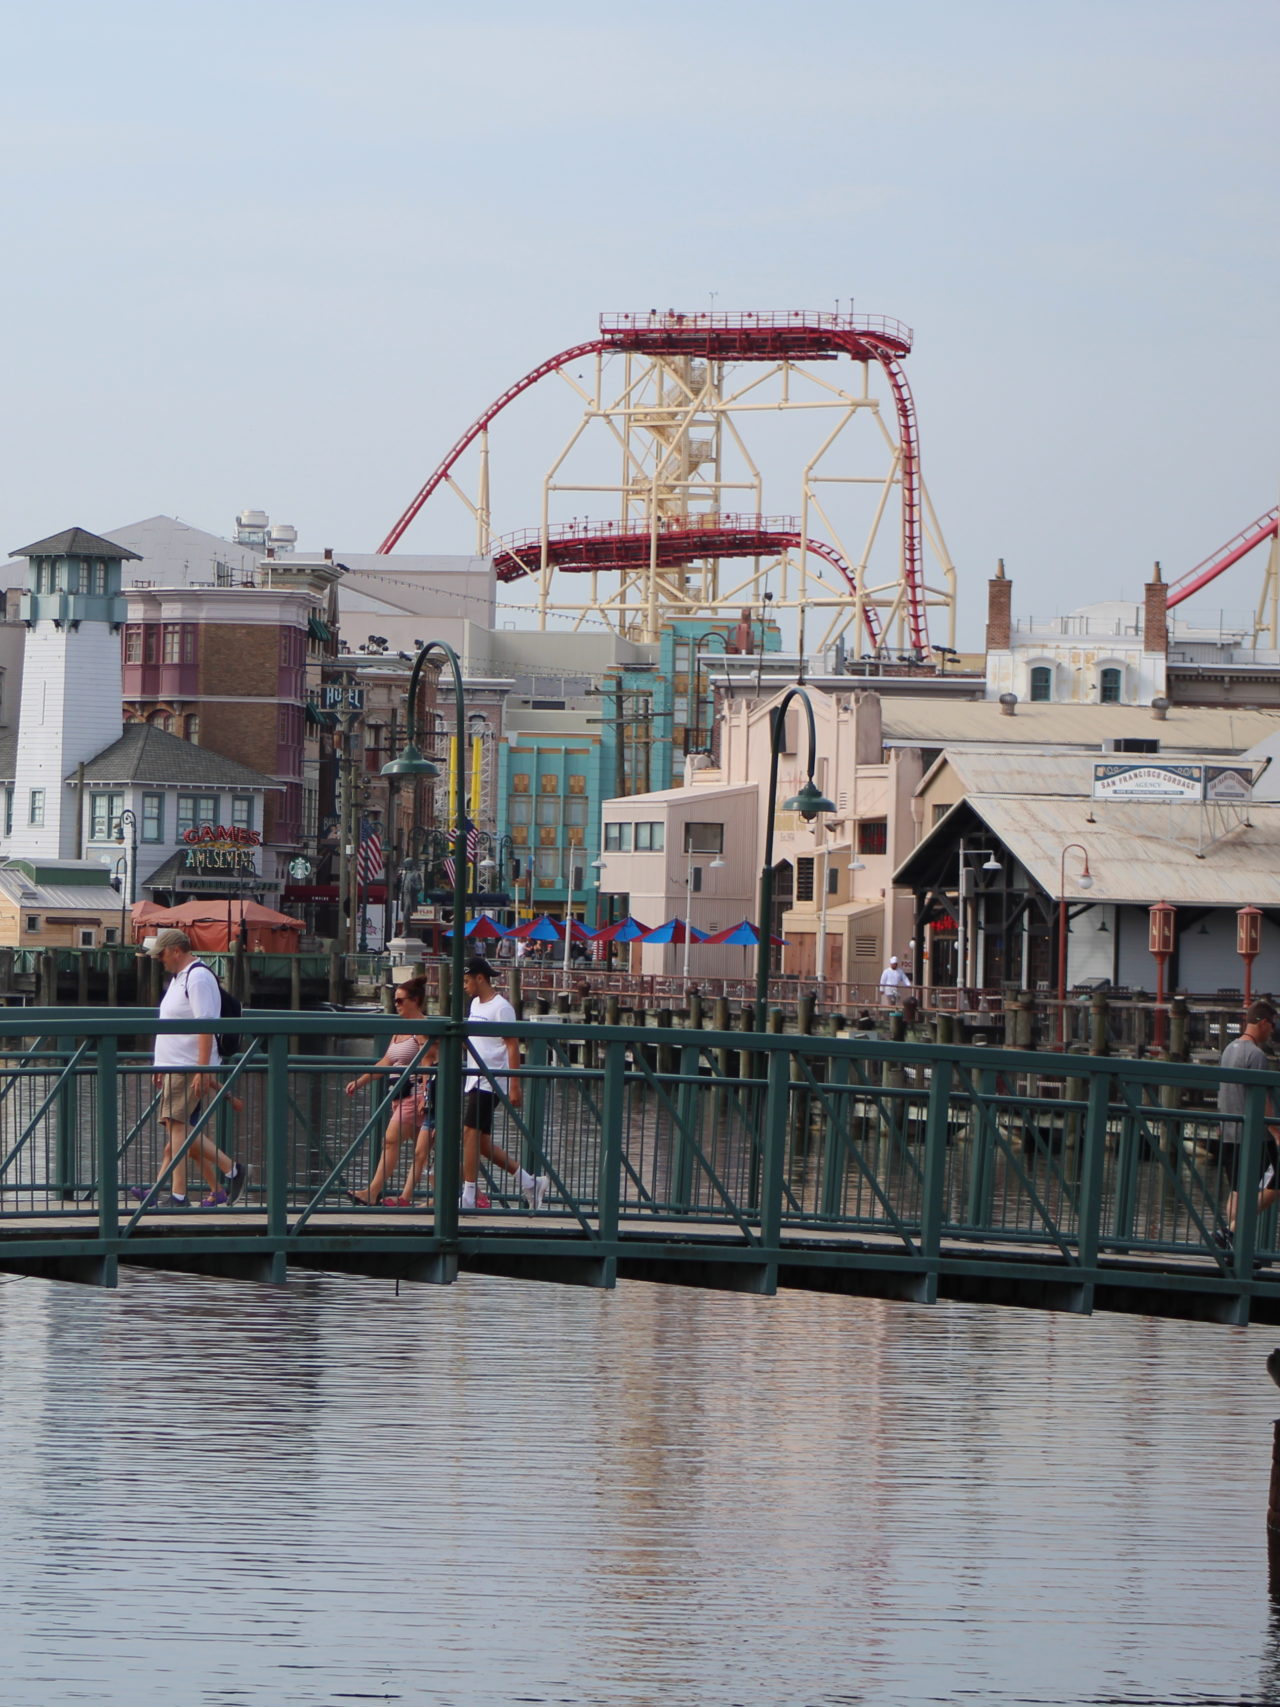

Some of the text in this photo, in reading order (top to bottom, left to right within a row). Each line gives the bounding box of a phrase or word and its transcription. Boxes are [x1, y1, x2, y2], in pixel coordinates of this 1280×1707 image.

[327, 687, 360, 707] HOEL
[1101, 769, 1196, 791] SAN FRANCISCO CORDAGE
[1134, 781, 1161, 789] AGENCY
[183, 825, 261, 847] GAMES
[186, 849, 256, 869] AMUSEMENT
